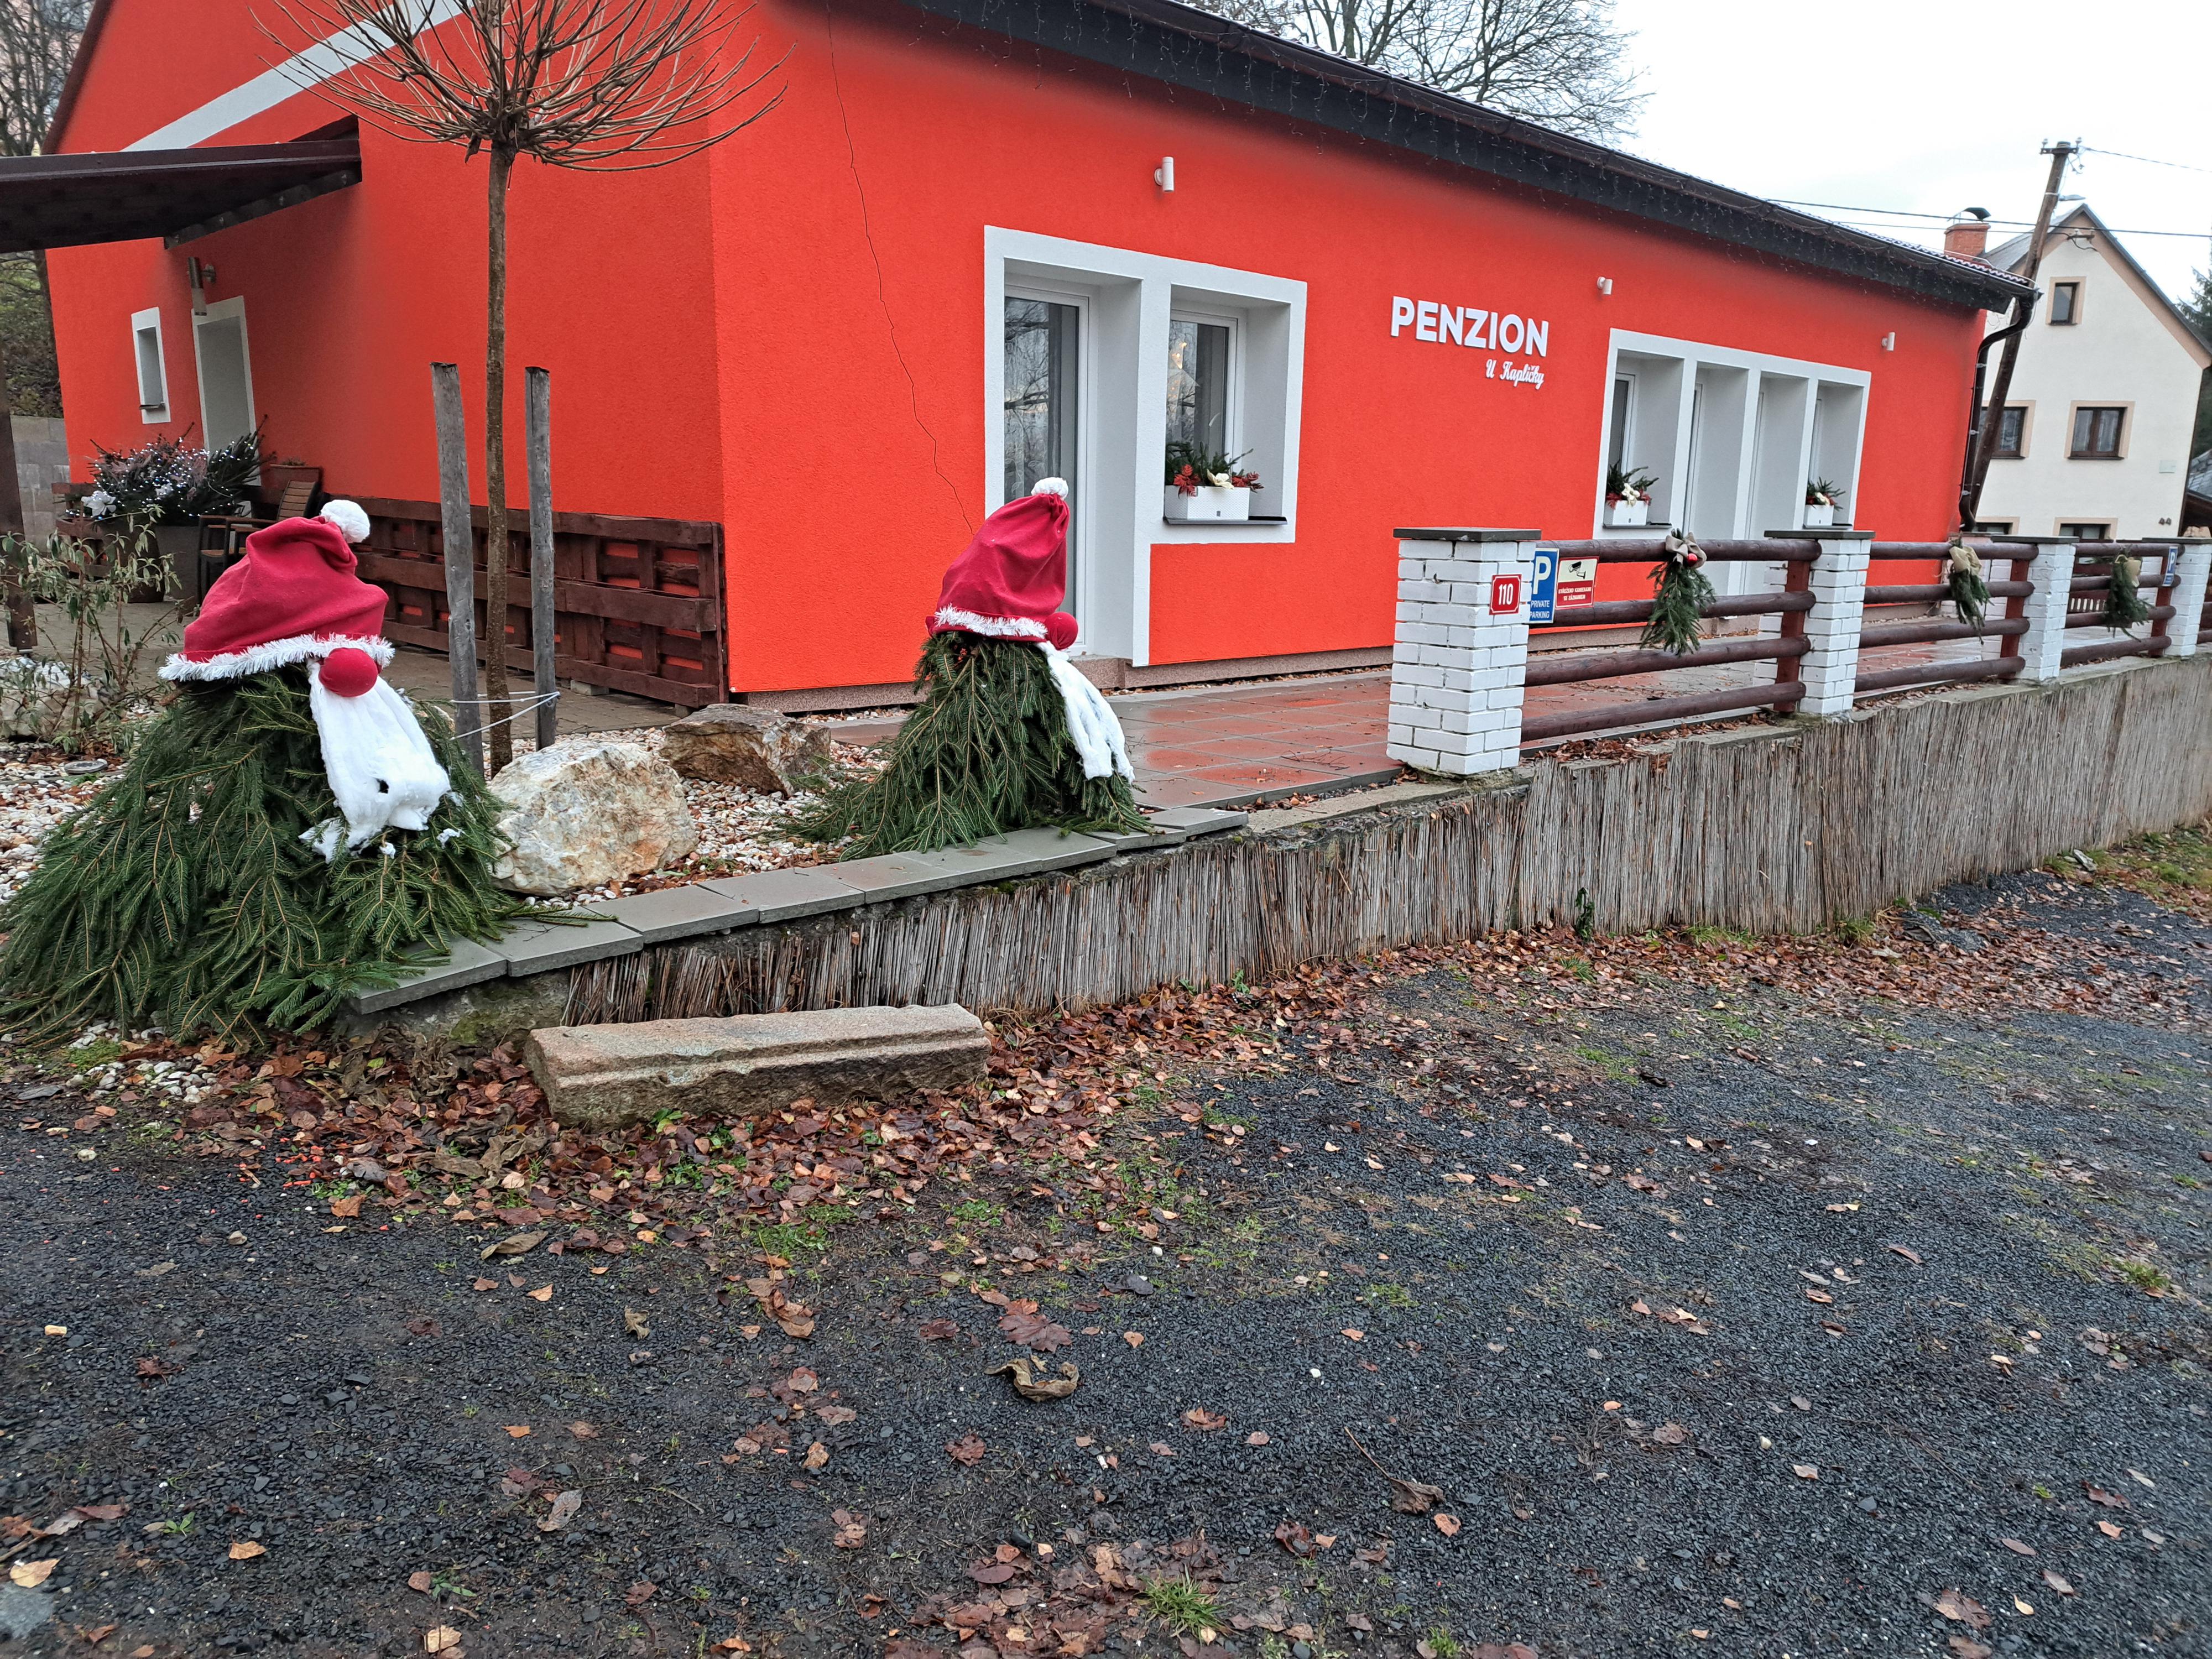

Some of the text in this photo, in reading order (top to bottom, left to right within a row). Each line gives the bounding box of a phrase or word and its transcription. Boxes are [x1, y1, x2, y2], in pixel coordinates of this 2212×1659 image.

[1390, 295, 1549, 357] PENZION
[1486, 359, 1545, 390] U Kapličky
[1532, 556, 1552, 594] P
[1499, 583, 1514, 605] 110
[1530, 611, 1550, 619] PARKING
